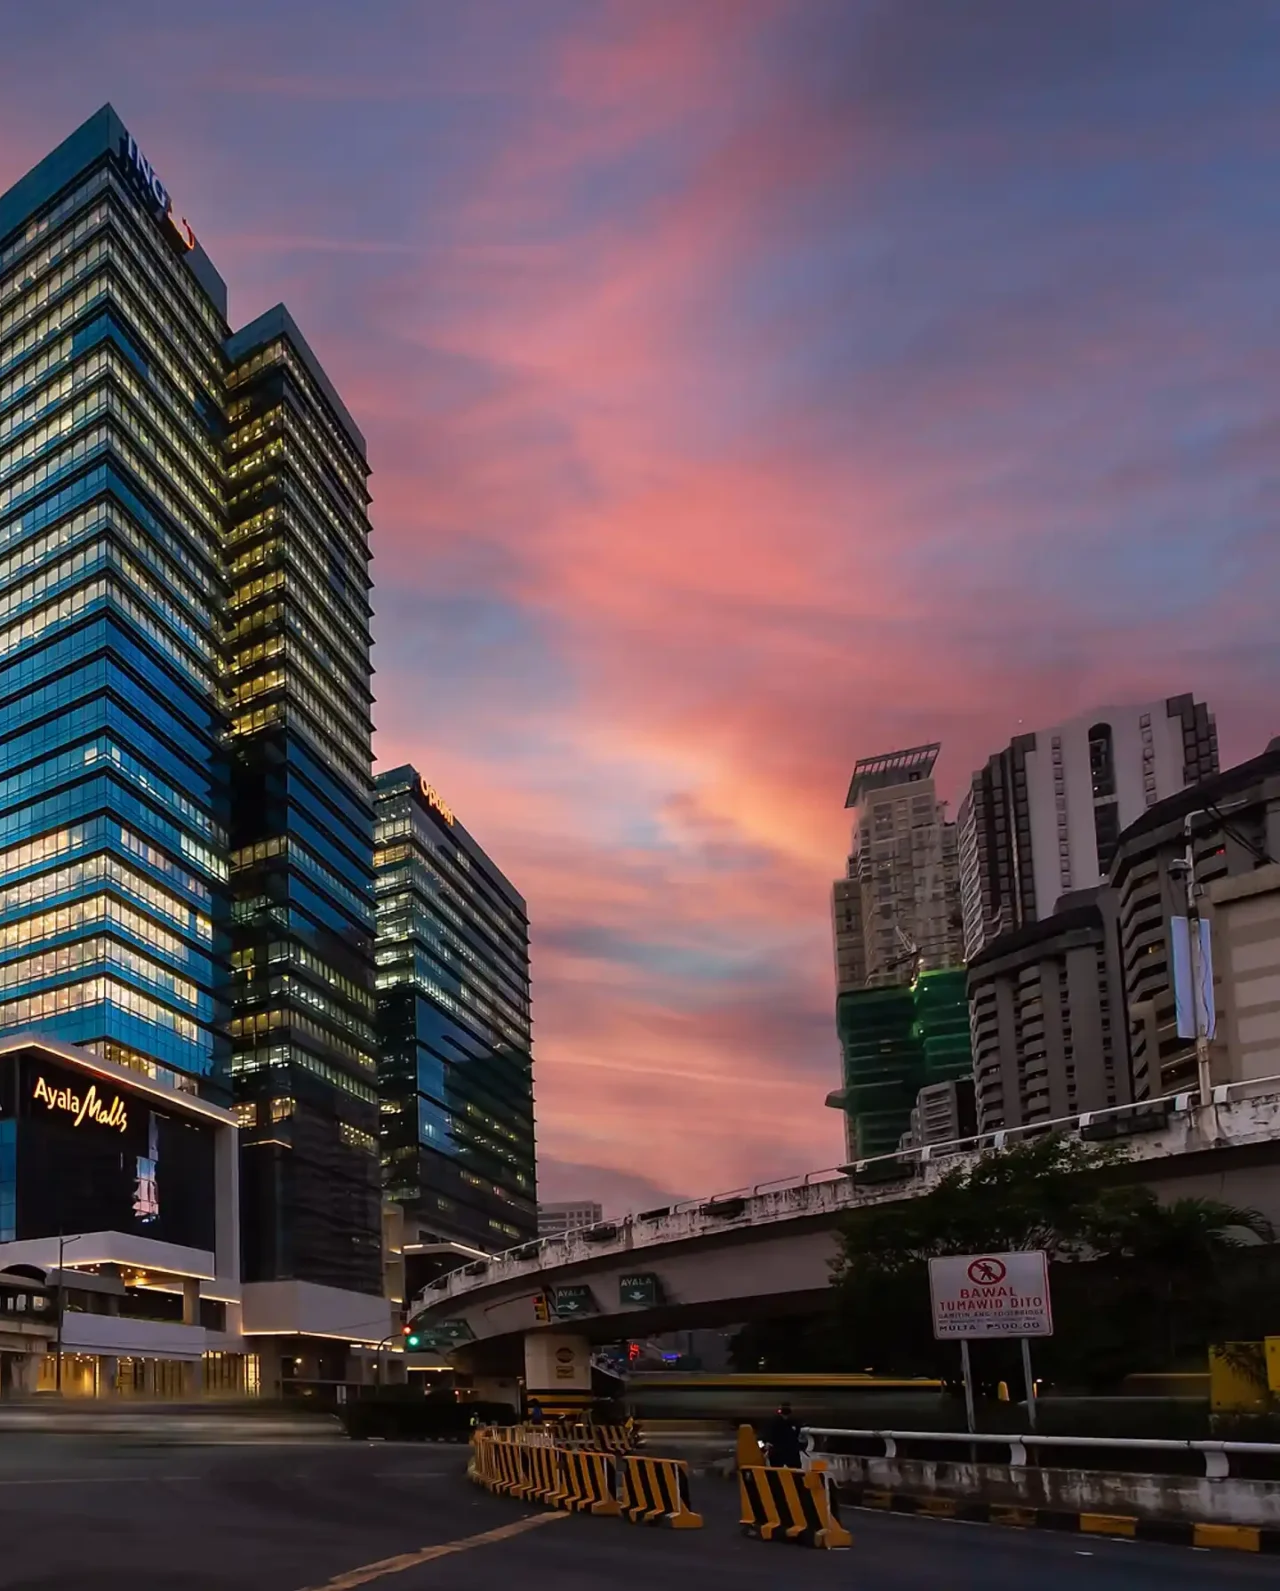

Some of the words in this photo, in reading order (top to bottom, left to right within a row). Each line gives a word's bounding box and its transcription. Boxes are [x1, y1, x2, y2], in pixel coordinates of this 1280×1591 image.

[128, 133, 166, 208] ING
[33, 1077, 80, 1113] Ayala
[73, 1085, 128, 1133] Malls
[621, 1278, 652, 1287] AYALA
[558, 1289, 586, 1297] AYALA
[960, 1286, 1017, 1299] BAWAL
[940, 1299, 1003, 1312] TUMAWID
[1011, 1297, 1043, 1309] DITO
[940, 1324, 977, 1332] MULTA
